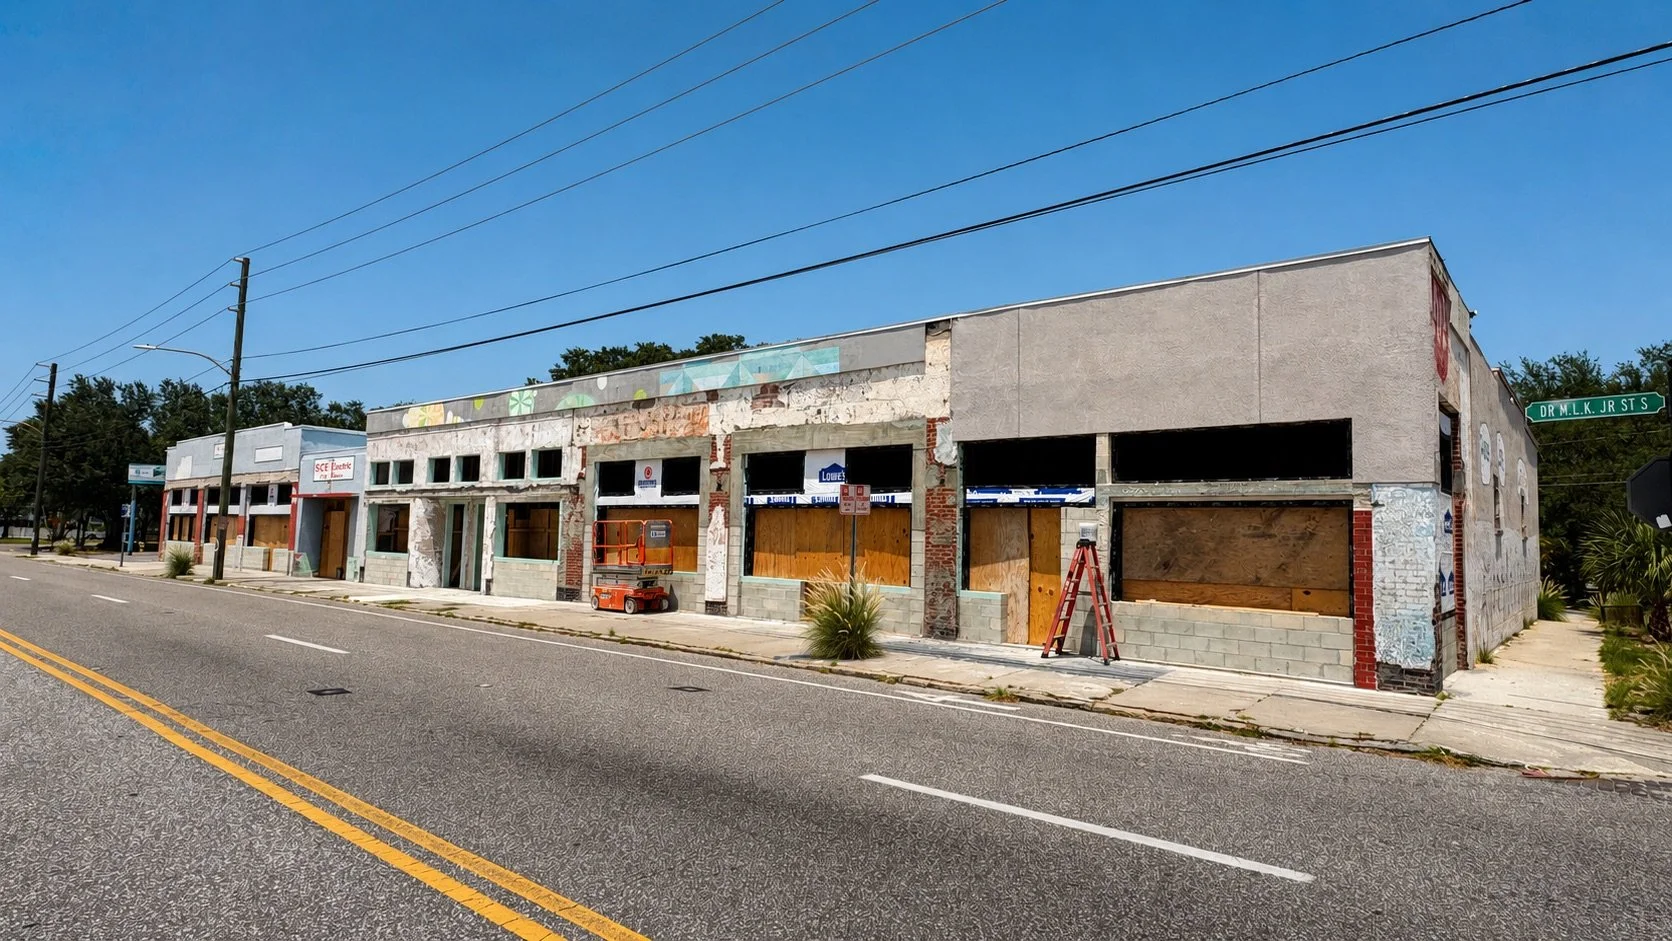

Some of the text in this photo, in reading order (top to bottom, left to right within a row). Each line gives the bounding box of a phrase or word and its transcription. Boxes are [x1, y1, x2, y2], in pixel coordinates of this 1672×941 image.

[1540, 397, 1648, 418] DR M.L.K. JR ST S
[315, 462, 329, 473] SCE
